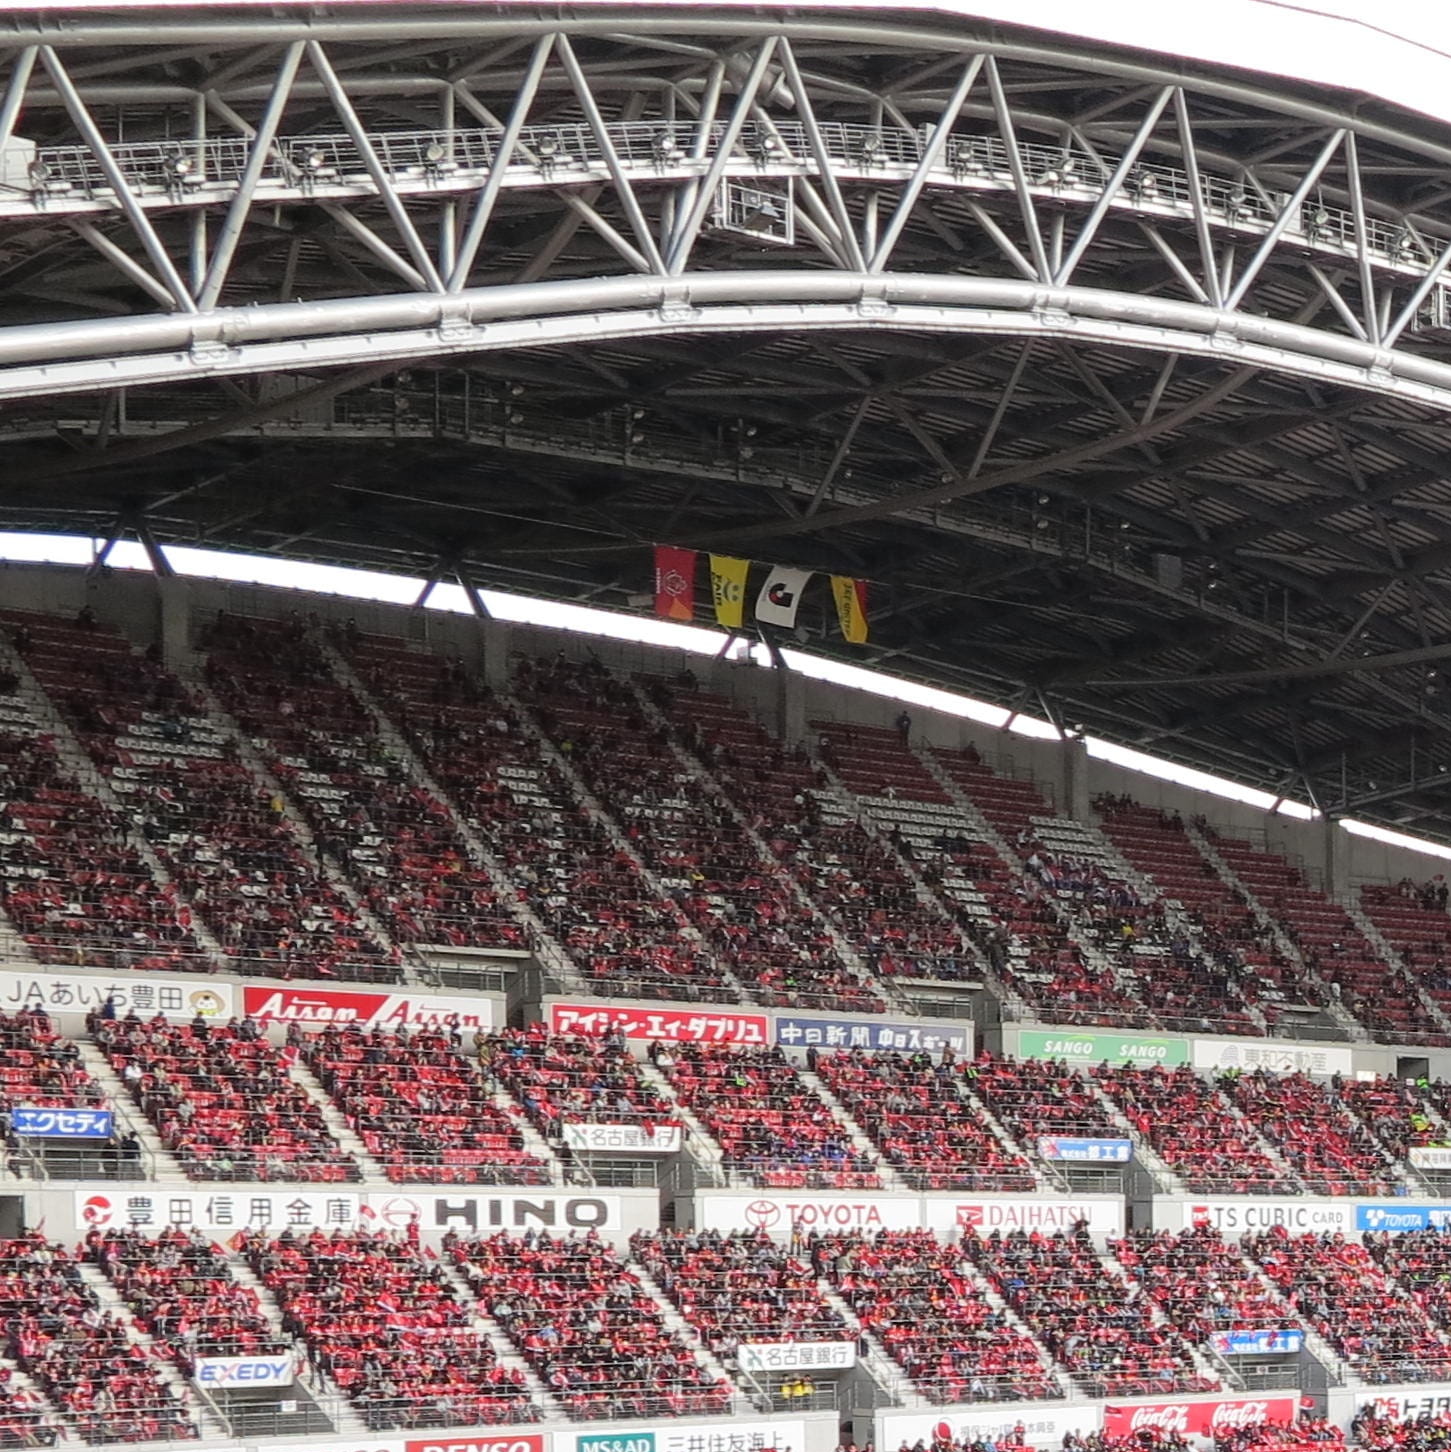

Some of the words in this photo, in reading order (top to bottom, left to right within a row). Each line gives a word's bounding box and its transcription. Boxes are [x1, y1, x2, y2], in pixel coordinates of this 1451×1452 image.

[8, 979, 183, 1010] JAあいち豊田
[780, 1022, 871, 1047] 中日新聞
[1044, 1040, 1094, 1056] SANGO
[1119, 1043, 1168, 1059] SANGO
[1244, 1048, 1327, 1071] 東和不動産
[17, 1111, 109, 1132] エクセディ
[590, 1128, 673, 1149] 名古屋銀行
[125, 1196, 353, 1225] 豊田信用金庫
[435, 1199, 608, 1227] HINO
[785, 1204, 881, 1226] TOYOTA
[988, 1205, 1093, 1227] DAIHATSU
[1244, 1208, 1307, 1227] CUBIC
[1312, 1212, 1344, 1224] CARD
[1384, 1214, 1423, 1227] TOYOTA
[766, 1346, 850, 1367] 名古屋銀行
[200, 1362, 288, 1382] EXEDY
[1129, 1403, 1189, 1432] Coca-Cola
[1211, 1400, 1268, 1425] Coca-Cola
